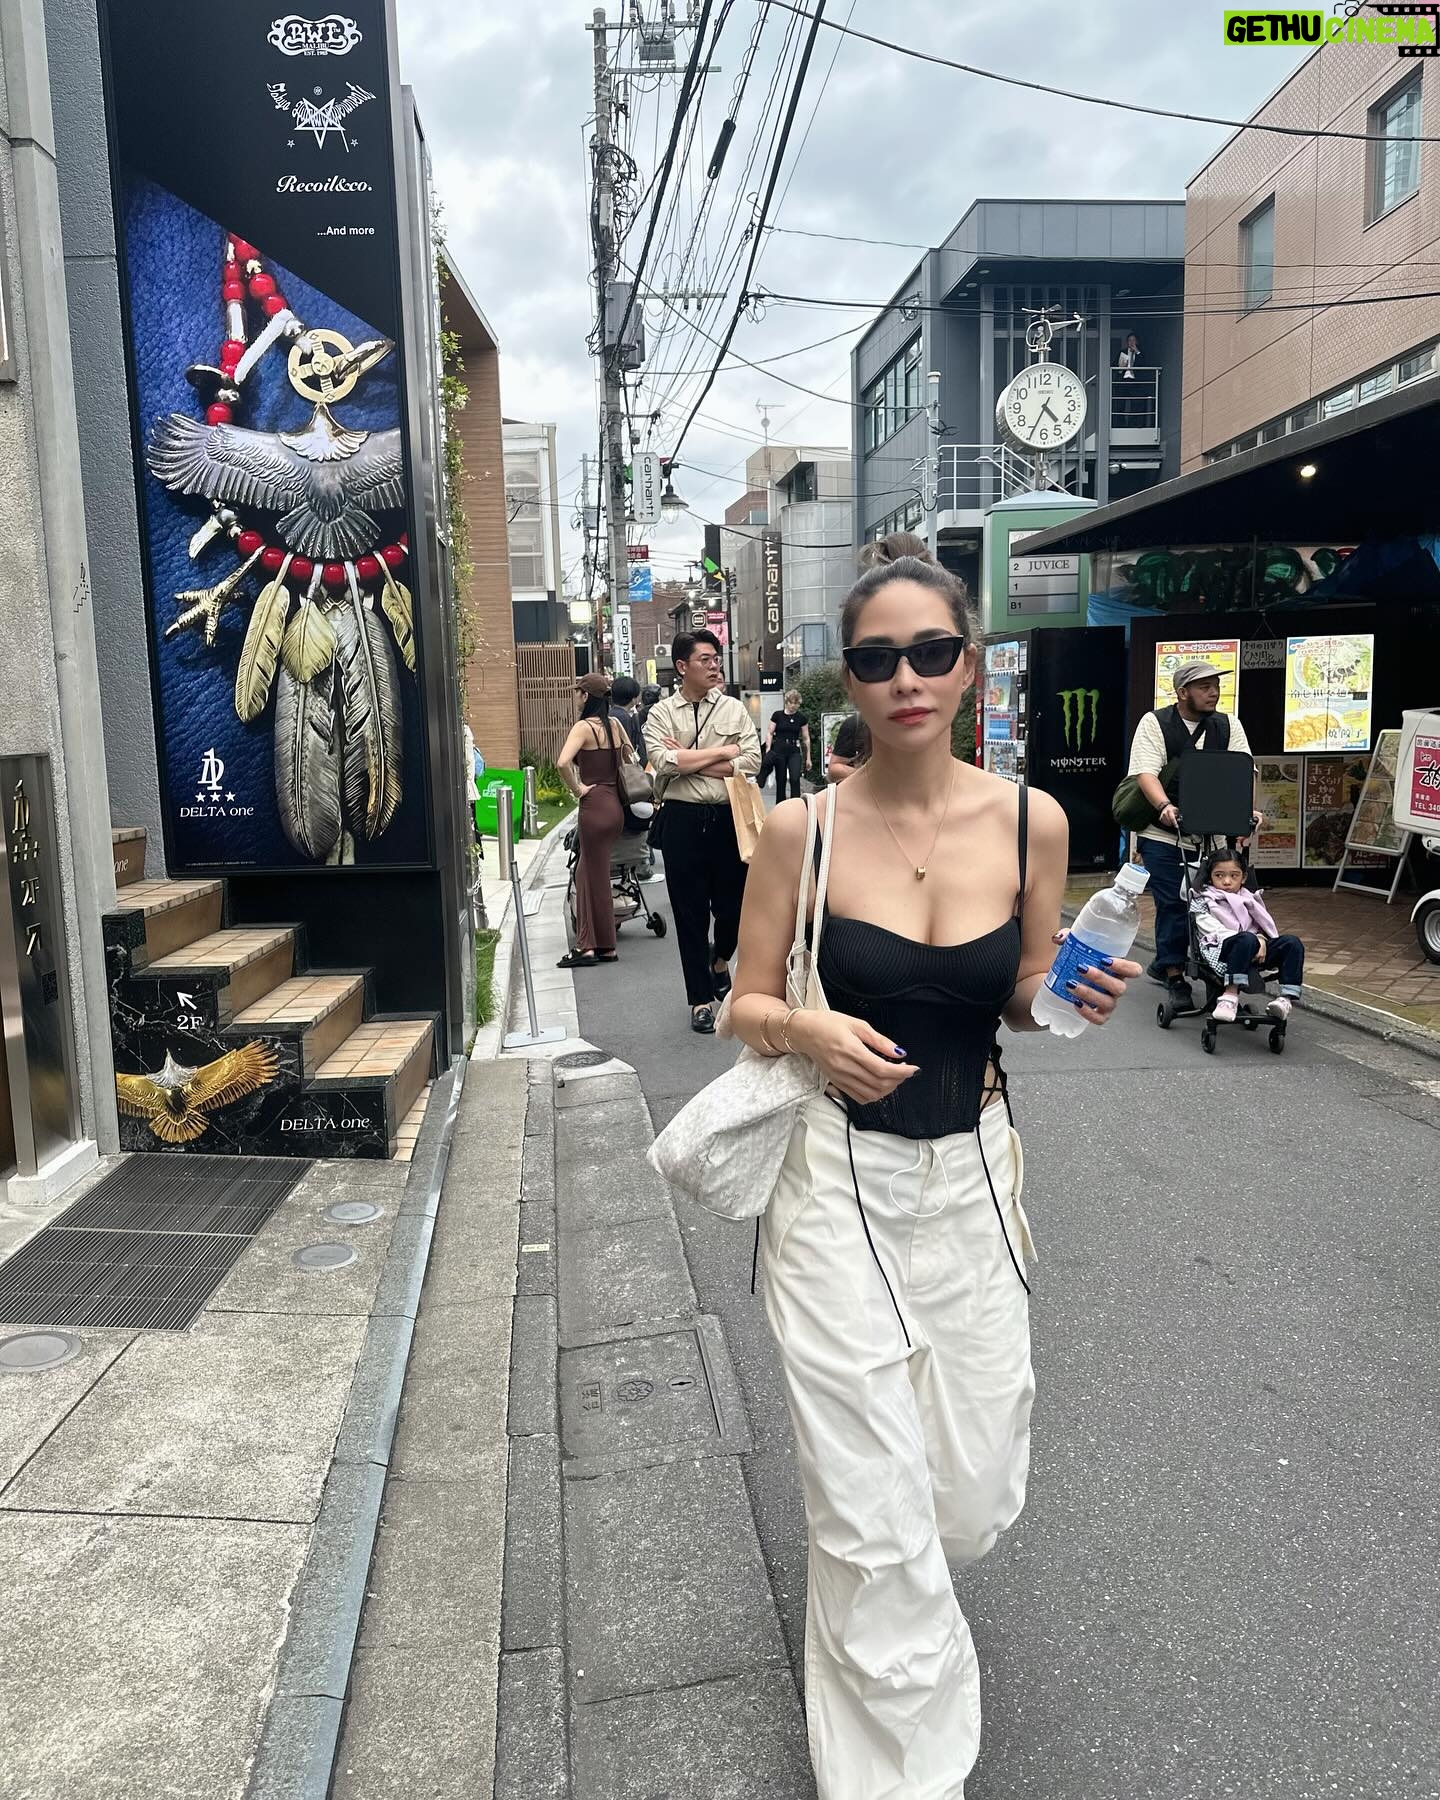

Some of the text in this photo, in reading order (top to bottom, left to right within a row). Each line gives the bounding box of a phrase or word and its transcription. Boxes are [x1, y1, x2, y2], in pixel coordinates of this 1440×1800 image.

[276, 175, 373, 192] Recoil&co.
[349, 227, 375, 235] more
[1040, 373, 1052, 385] 12
[1016, 388, 1028, 400] 10
[1064, 385, 1073, 397] 2
[1012, 402, 1021, 414] 9
[1067, 400, 1076, 411] 3
[1017, 415, 1026, 427] 8
[1063, 414, 1072, 425] 4
[1040, 428, 1048, 440] 6
[1053, 424, 1062, 436] 5
[1014, 559, 1070, 572] 2 JUVICE
[765, 536, 780, 634] carhartt
[1014, 583, 1018, 591] 1
[1010, 601, 1022, 610] B1
[1050, 756, 1107, 768] MONSTER
[1308, 794, 1333, 805] 定食
[1415, 801, 1426, 810] TEL
[180, 806, 254, 817] DELTA one
[177, 1015, 204, 1030] 2F
[280, 1116, 371, 1131] DELTA one
